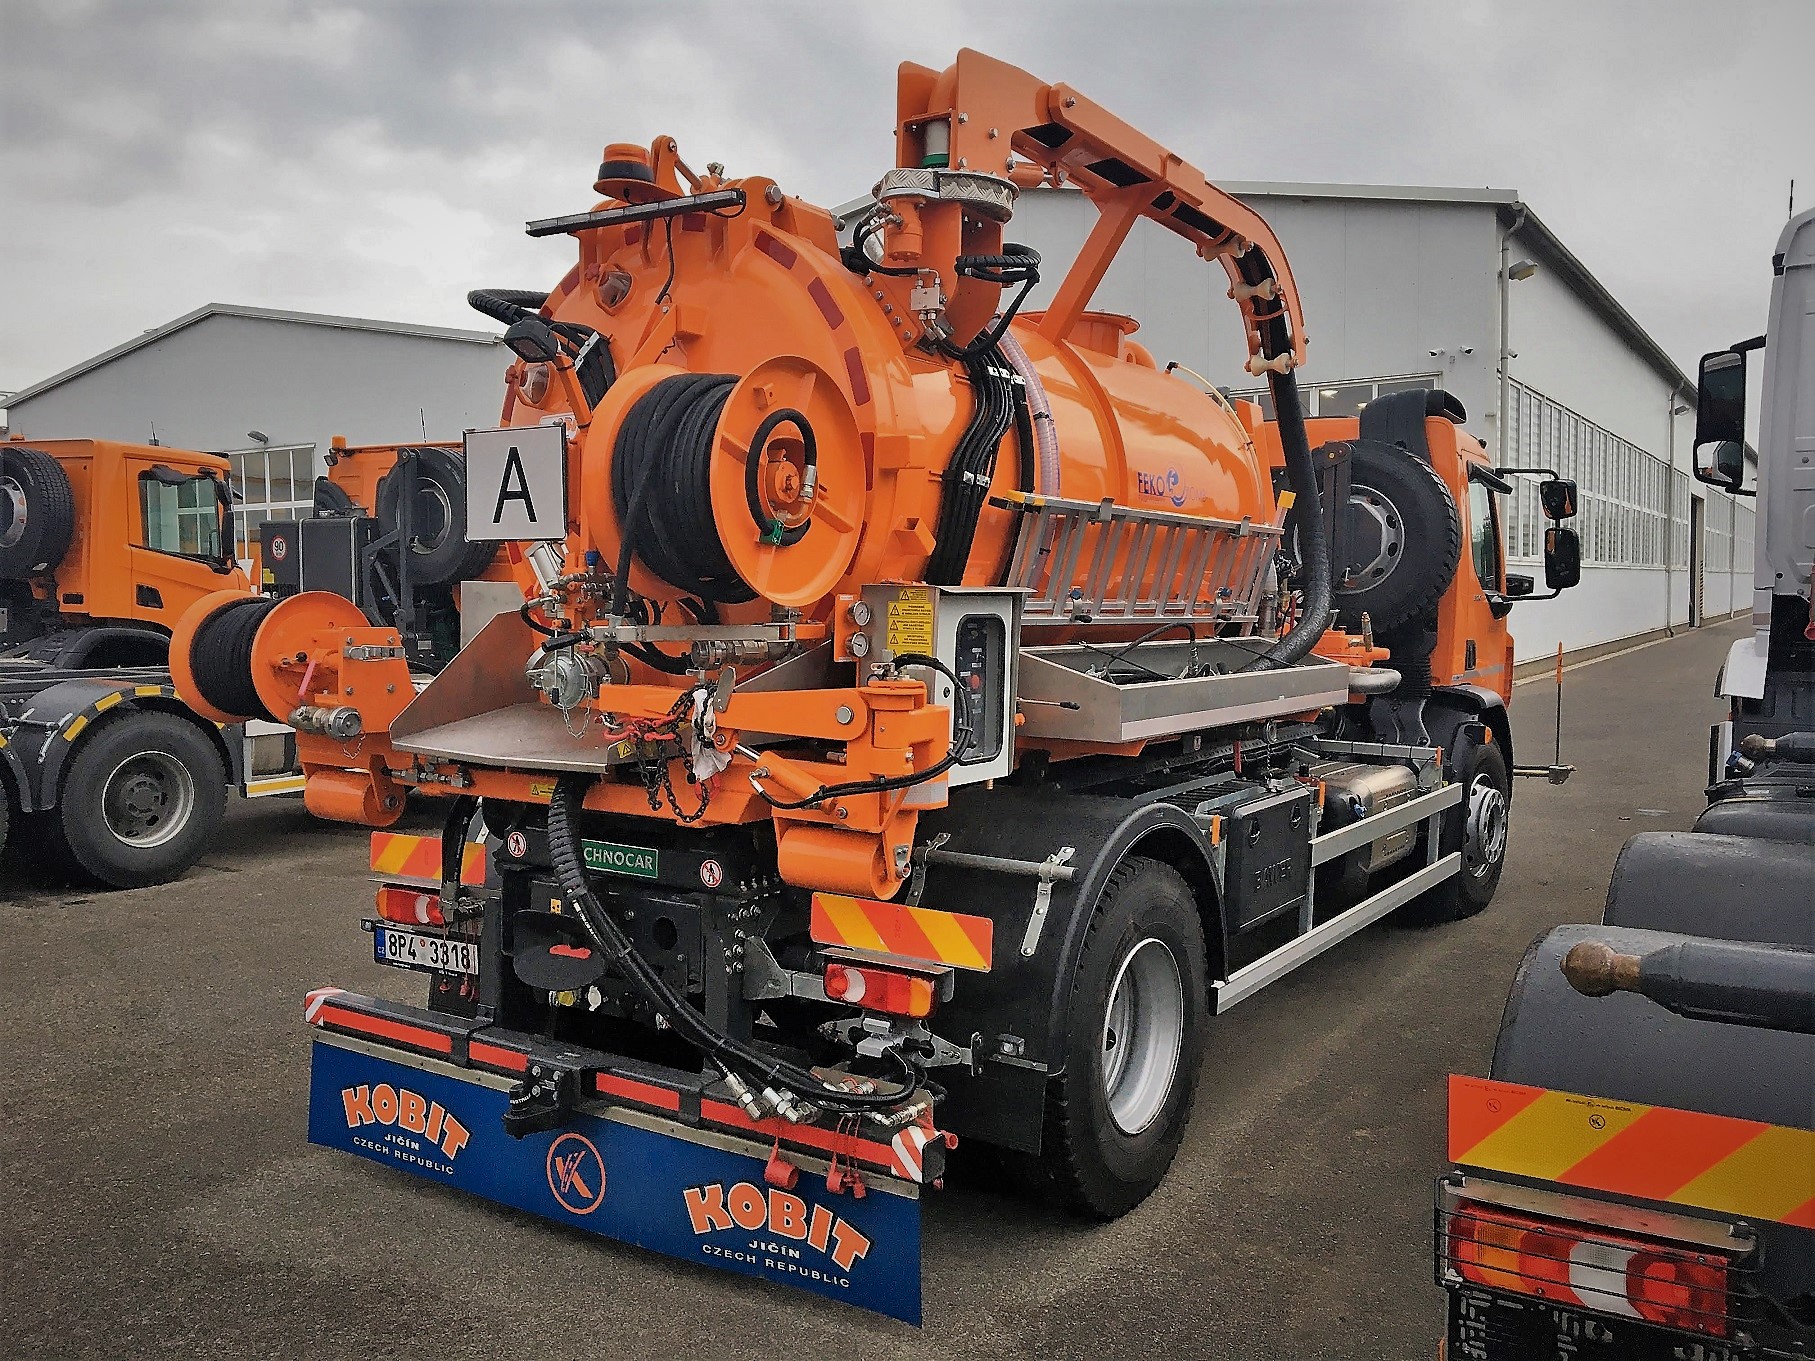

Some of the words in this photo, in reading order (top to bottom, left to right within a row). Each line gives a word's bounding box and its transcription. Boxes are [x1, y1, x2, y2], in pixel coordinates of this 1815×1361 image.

[492, 446, 538, 523] A
[1137, 471, 1165, 497] FEKO
[274, 540, 284, 552] 90
[583, 847, 654, 871] CHNOCAR
[388, 933, 418, 961] 8P4
[341, 1083, 471, 1161] KOBIT
[353, 1136, 389, 1155] CZECH
[394, 1149, 454, 1175] REPUBLIC
[384, 1133, 420, 1151] JIČÍN
[683, 1182, 871, 1273] KOBIT
[748, 1239, 800, 1259] JIČÍN
[702, 1243, 756, 1264] CZECH
[765, 1258, 850, 1288] REPUBLIC
